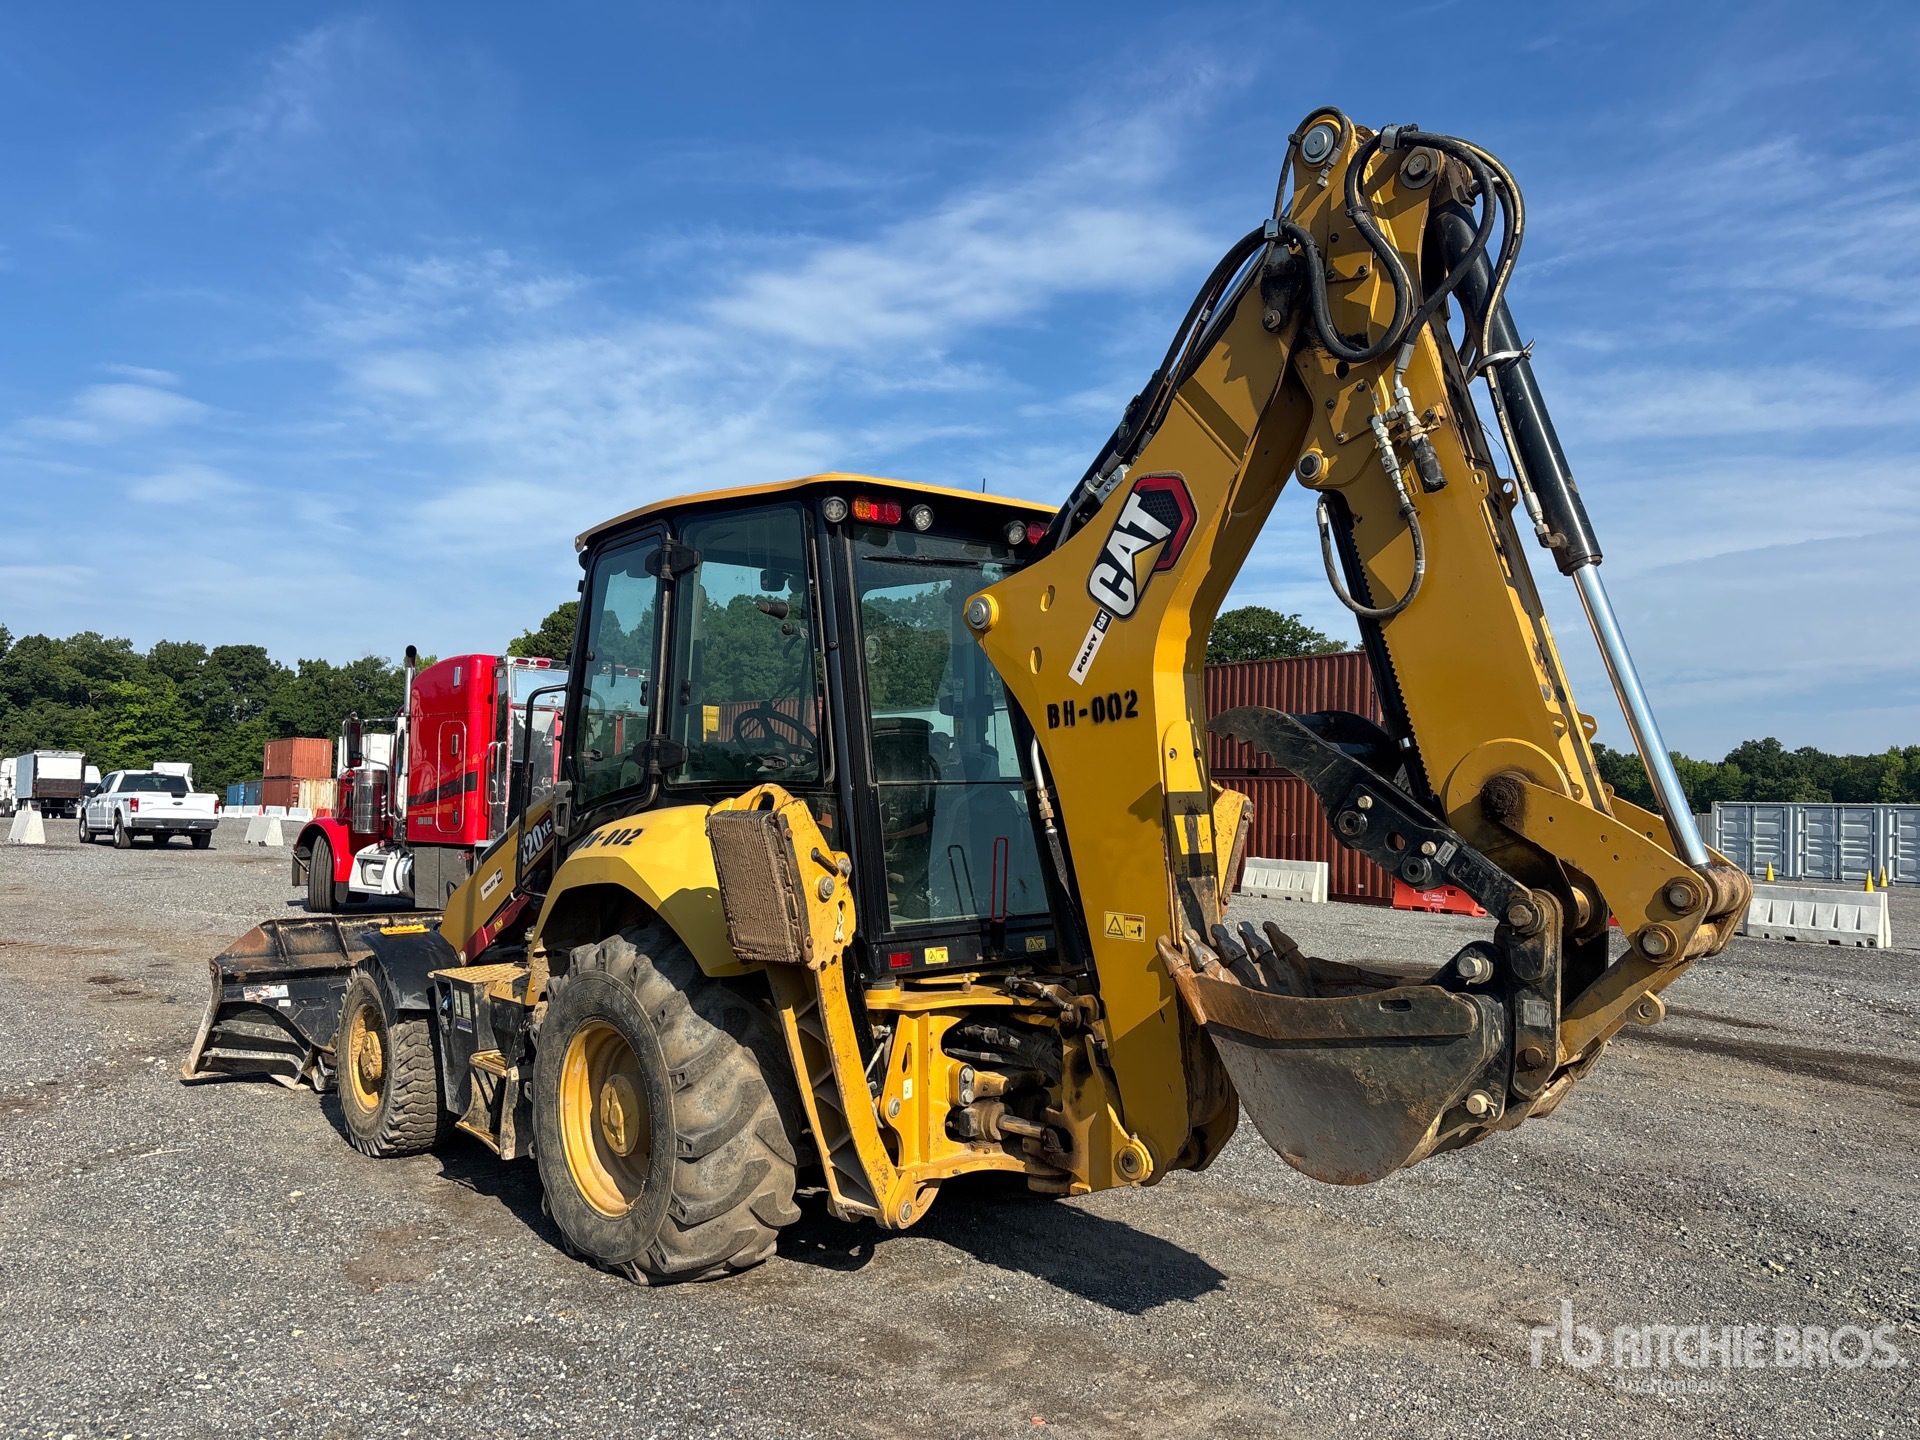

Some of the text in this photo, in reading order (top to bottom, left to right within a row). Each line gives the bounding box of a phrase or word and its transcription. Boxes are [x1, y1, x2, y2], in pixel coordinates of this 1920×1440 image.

[1090, 492, 1172, 617] CAT
[1077, 612, 1108, 673] FOLEY CAT
[1047, 690, 1139, 730] BH-002
